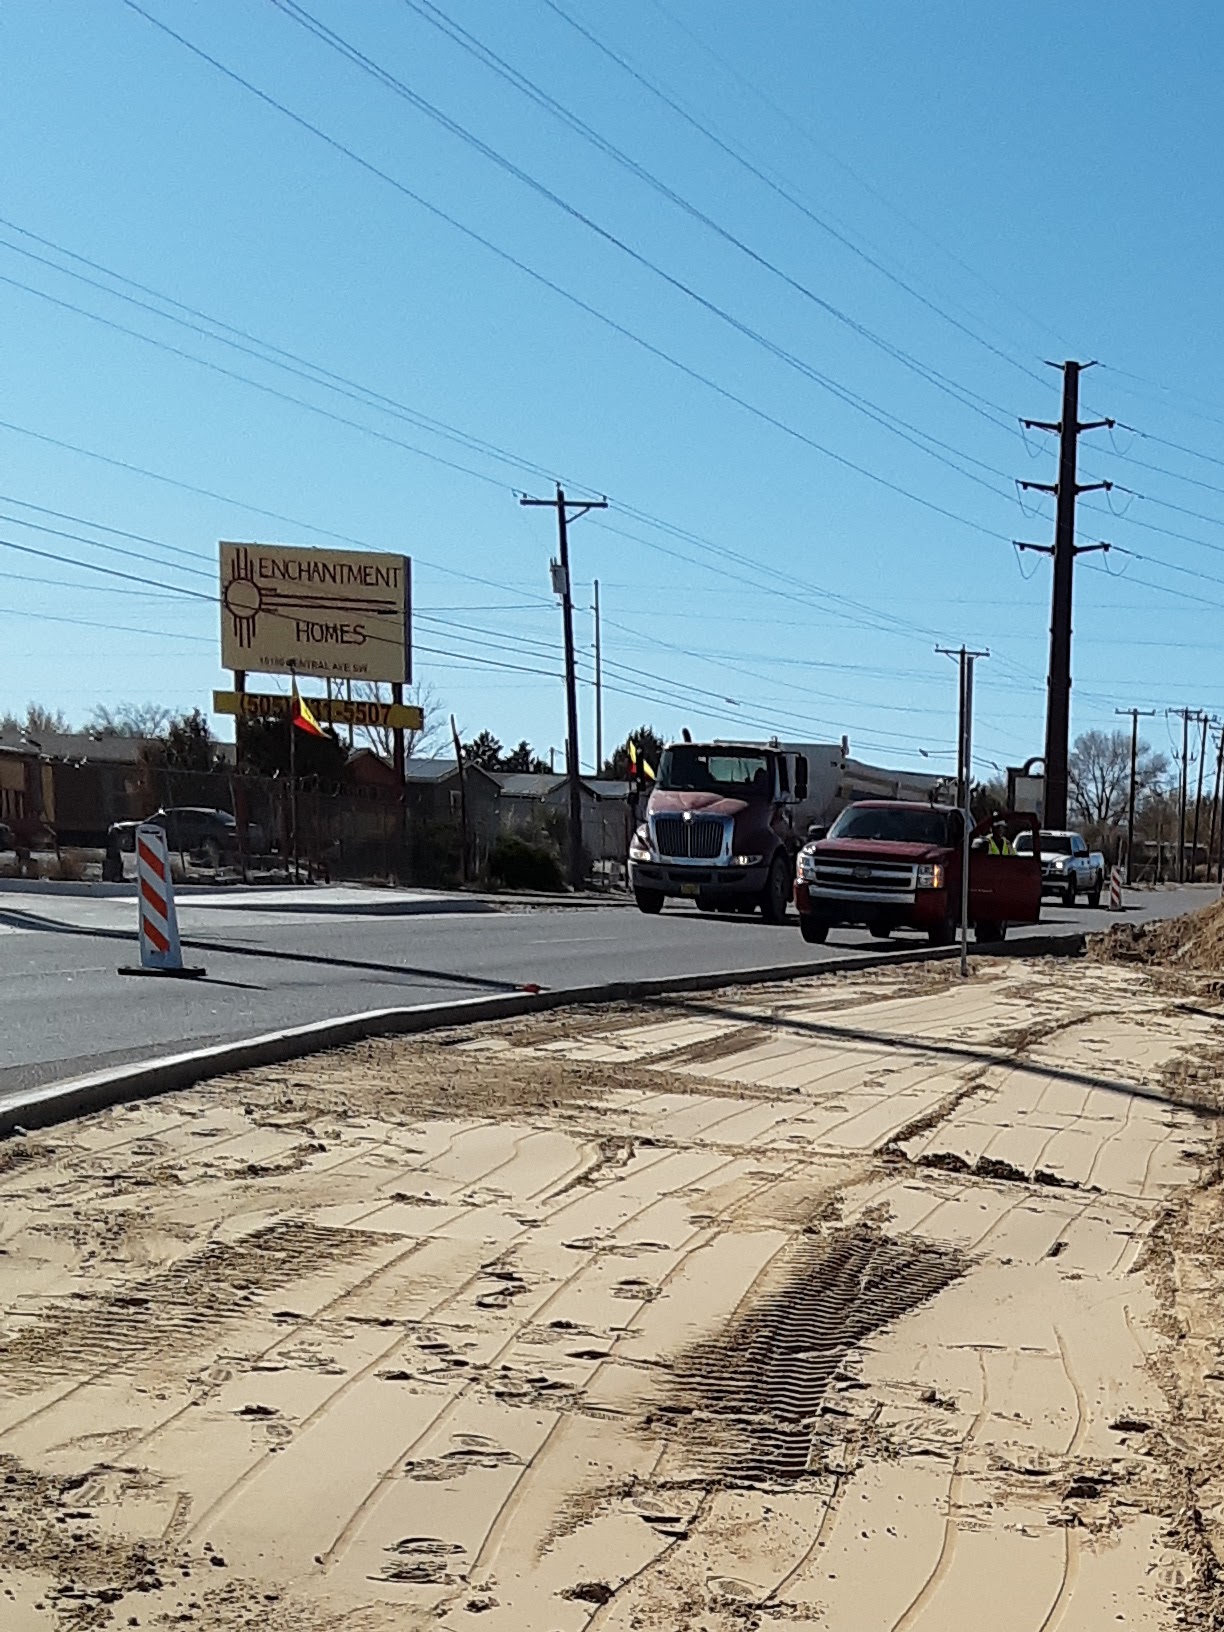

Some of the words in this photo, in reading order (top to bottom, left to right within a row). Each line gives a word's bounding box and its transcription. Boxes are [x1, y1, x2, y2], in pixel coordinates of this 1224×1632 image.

[258, 556, 401, 588] ENCHANTMENT
[296, 621, 367, 645] HOMES
[286, 657, 329, 670] NTRAL
[332, 662, 350, 672] AVE
[352, 663, 369, 673] SW
[300, 698, 392, 725] 31-5507
